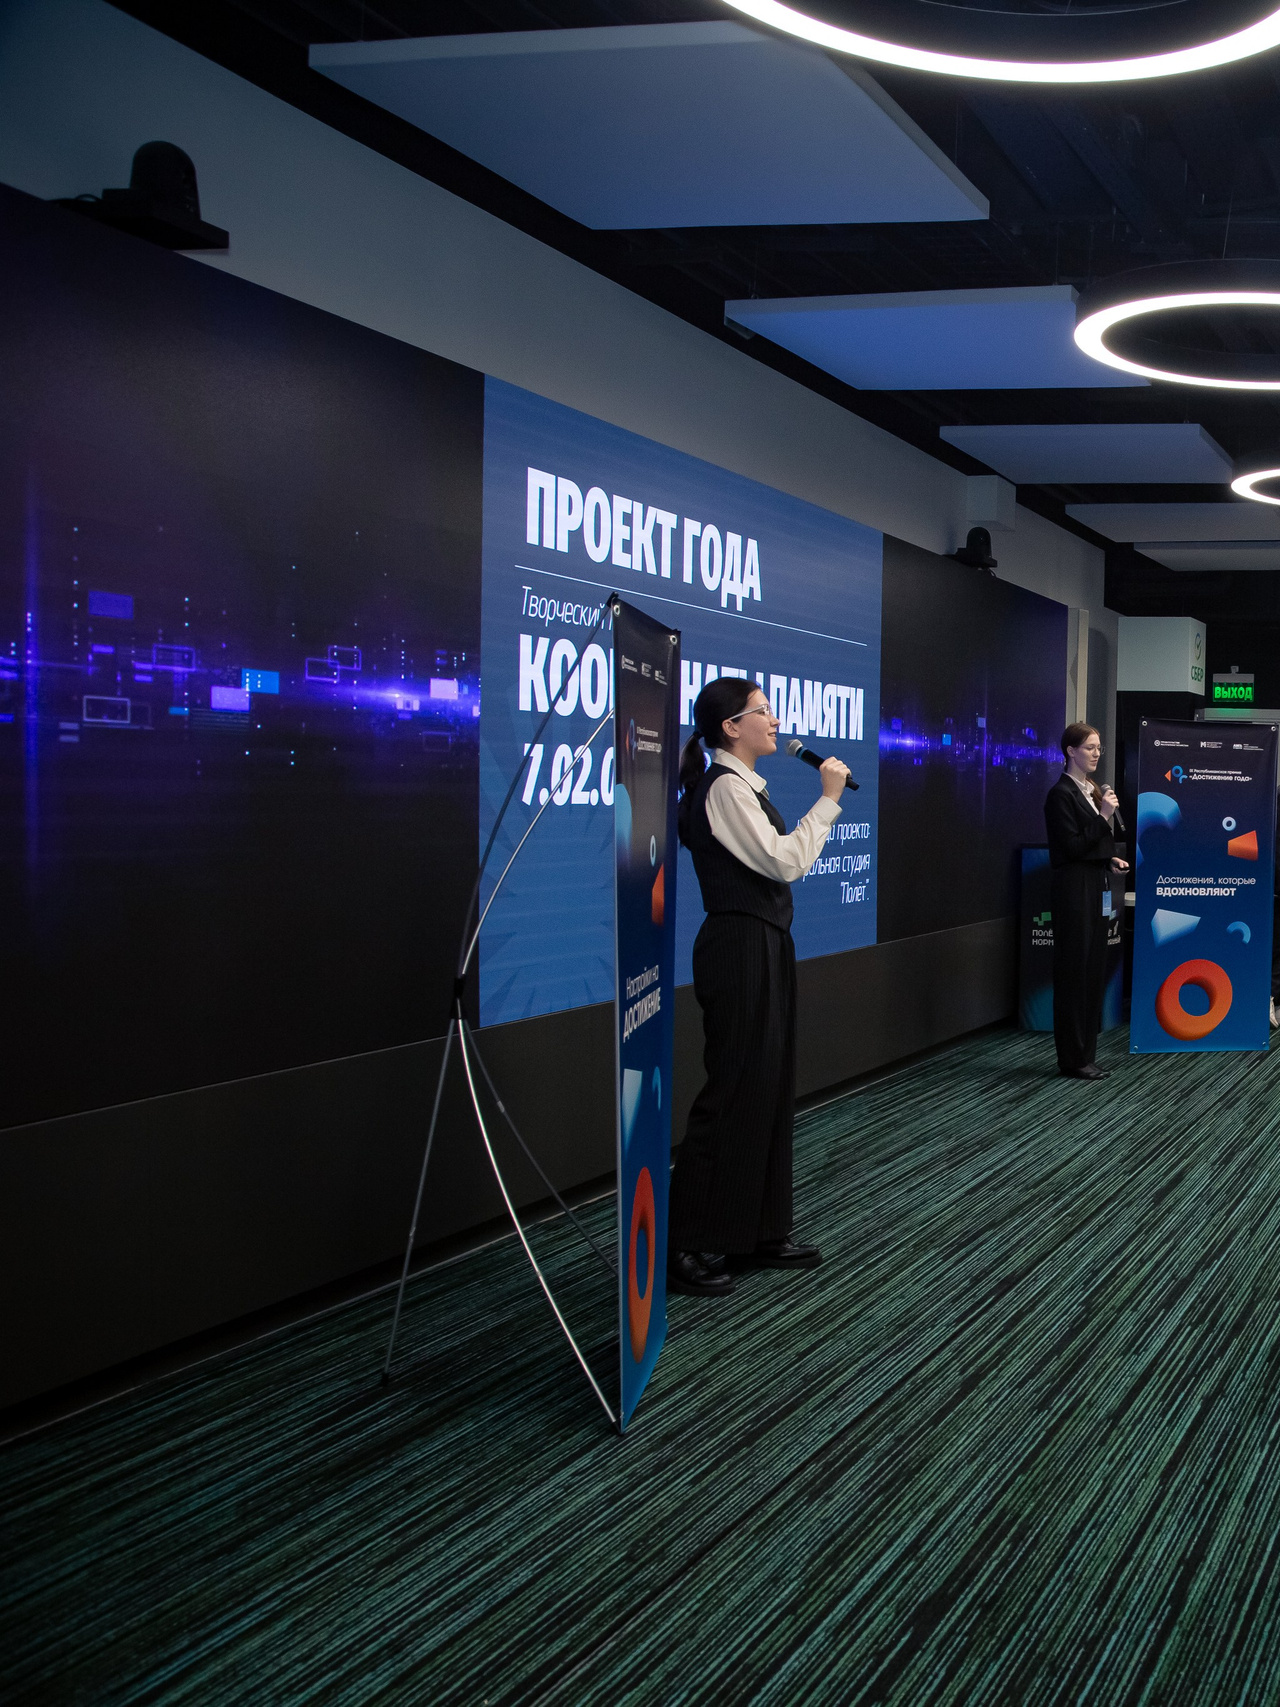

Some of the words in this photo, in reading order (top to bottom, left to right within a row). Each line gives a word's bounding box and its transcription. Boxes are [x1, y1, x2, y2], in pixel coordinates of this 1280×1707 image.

[526, 467, 678, 579] ПРОЕКТ
[683, 518, 762, 612] ГОДА
[522, 585, 606, 630] Творческий
[1190, 665, 1204, 682] СБЕР
[1214, 686, 1253, 701] ВЫХОД
[770, 673, 864, 741] ПАМЯТИ
[837, 822, 871, 846] проекта:
[842, 853, 871, 878] студия
[1156, 874, 1217, 885] Достижения,
[1218, 877, 1257, 886] которые
[1156, 887, 1237, 897] ВДОХНОВЛЯЮТ
[1032, 928, 1054, 937] ПОЛЁ
